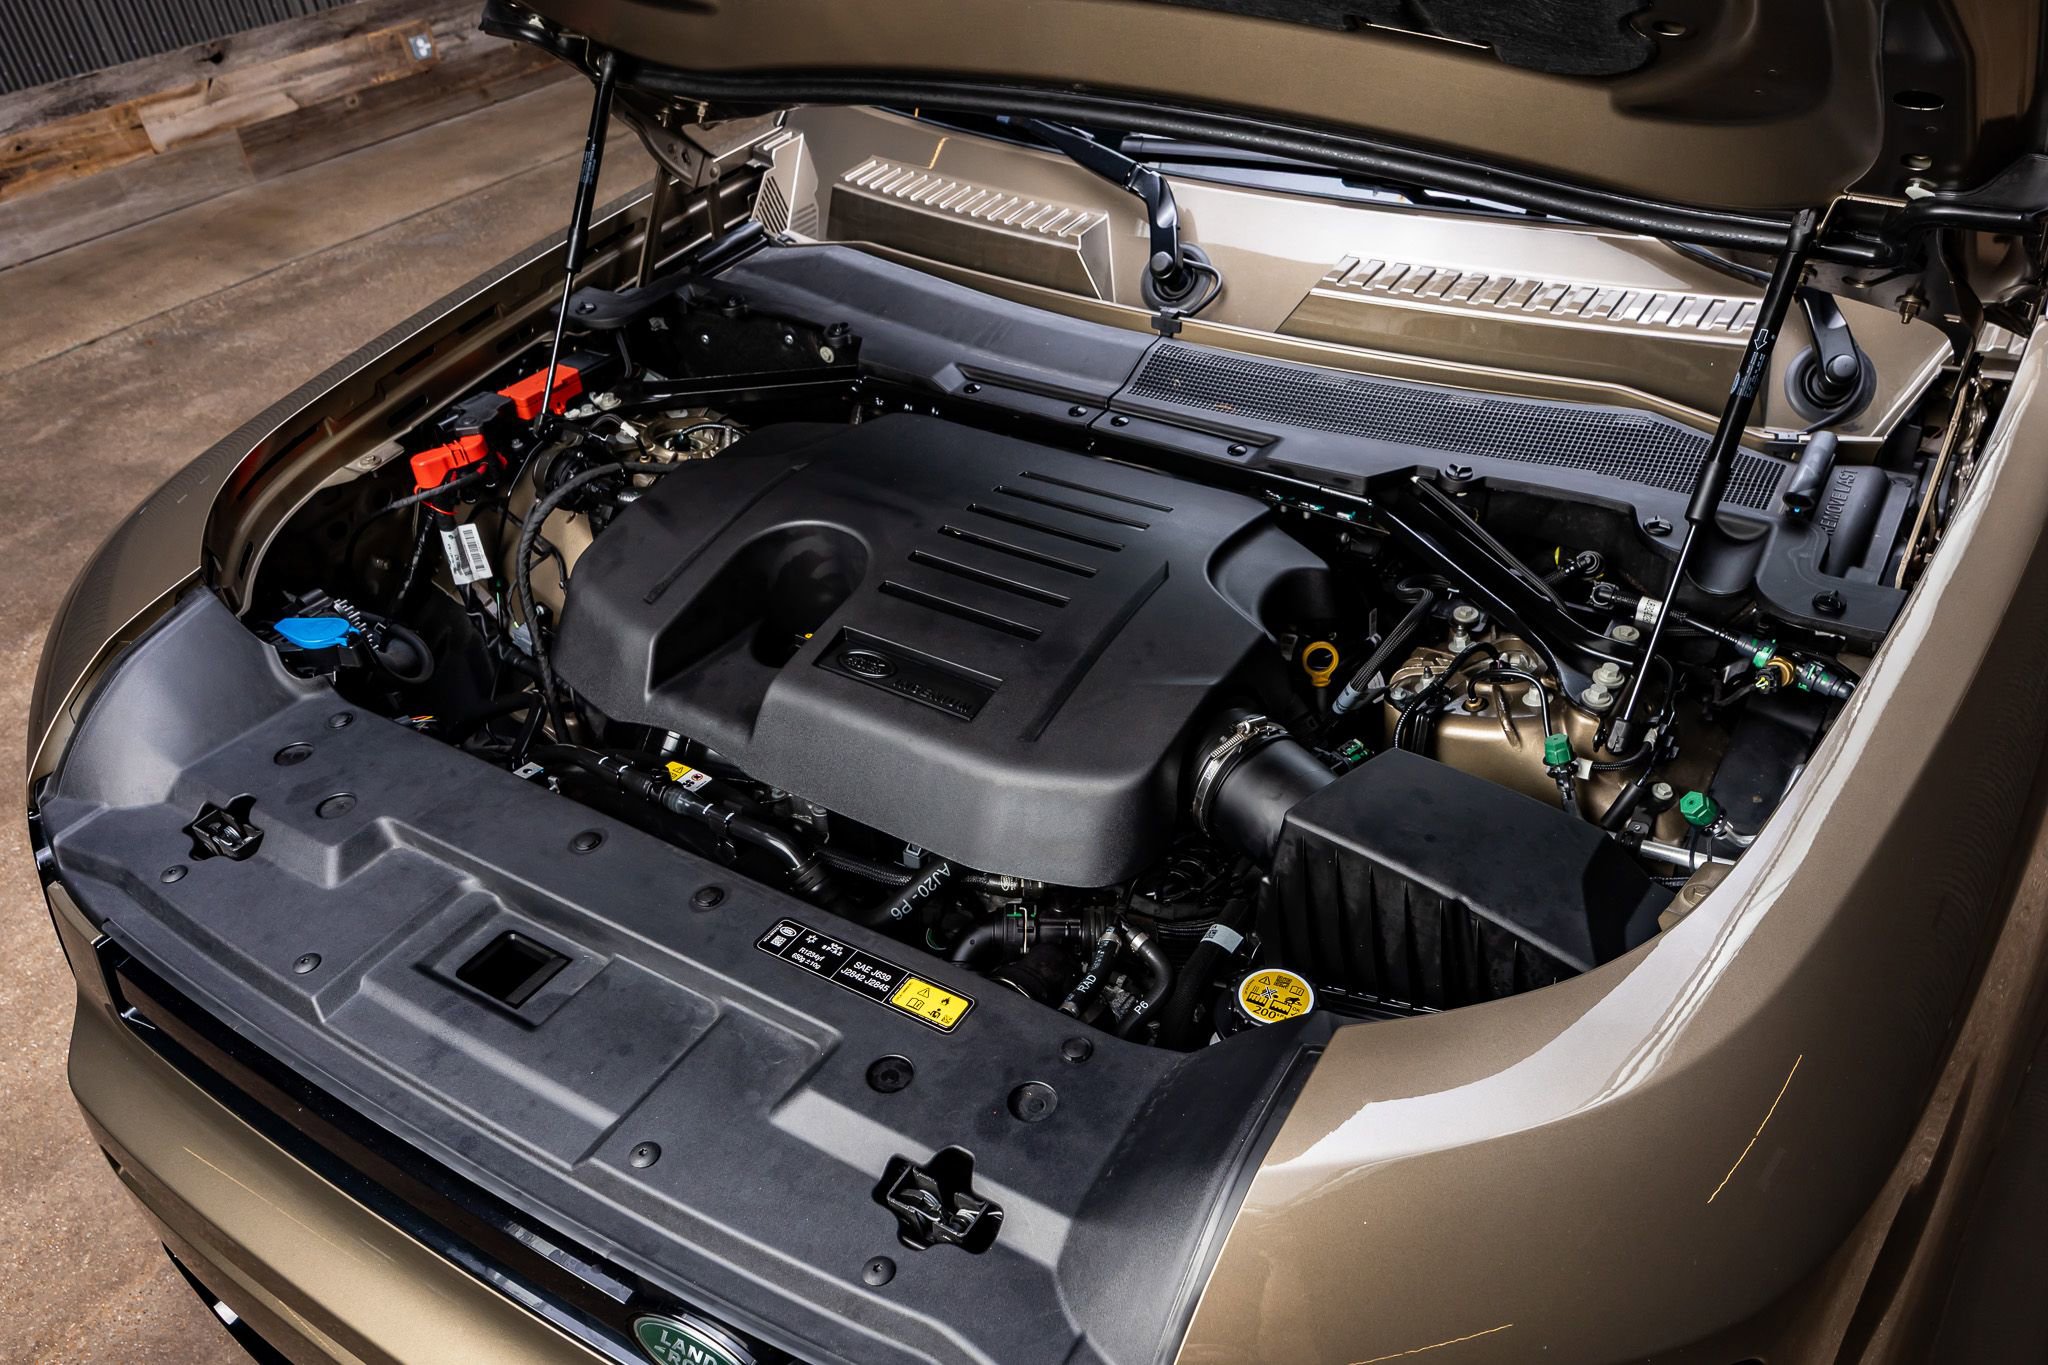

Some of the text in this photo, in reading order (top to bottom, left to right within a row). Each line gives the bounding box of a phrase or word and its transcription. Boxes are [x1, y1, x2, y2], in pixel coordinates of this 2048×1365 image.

[1834, 469, 1858, 495] LAST
[840, 967, 866, 982] J2842
[864, 978, 891, 992] J2845
[853, 961, 892, 982] SAE J639
[1077, 974, 1097, 993] RAD
[1133, 1000, 1149, 1015] P6
[1253, 1005, 1277, 1019] 200
[660, 1329, 718, 1365] LAND
